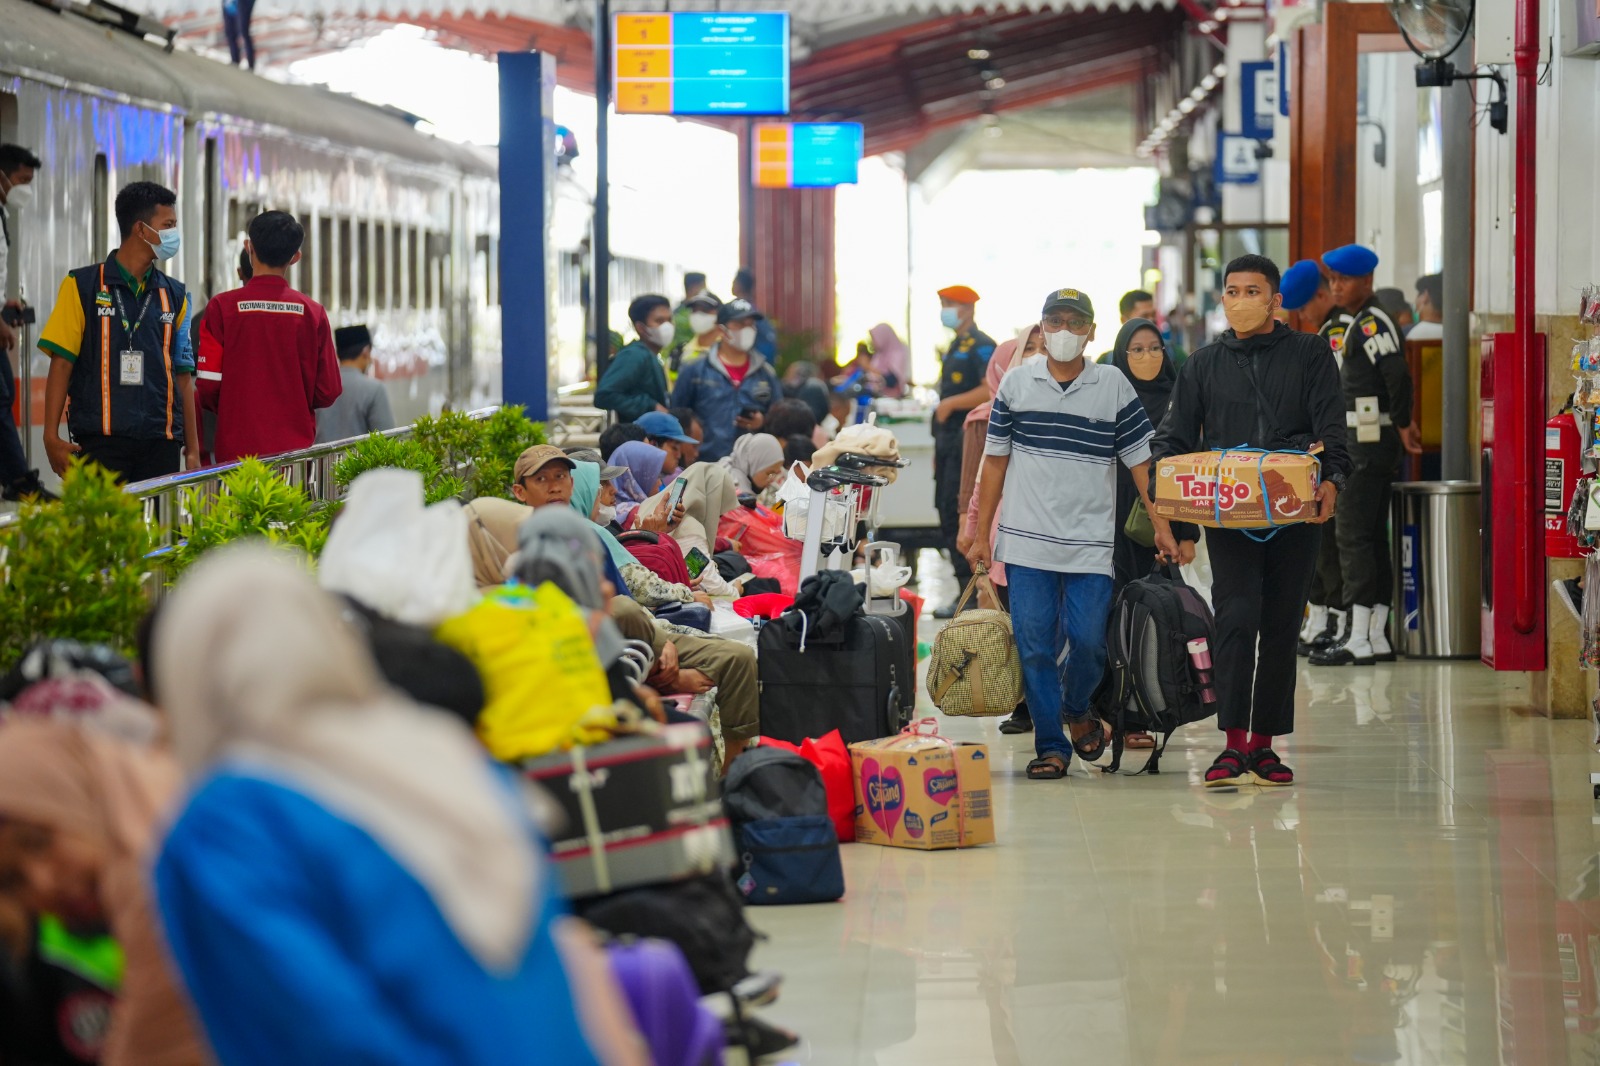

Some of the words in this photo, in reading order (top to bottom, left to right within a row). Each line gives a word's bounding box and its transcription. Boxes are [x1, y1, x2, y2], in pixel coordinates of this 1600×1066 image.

[97, 307, 115, 316] KAI
[239, 302, 265, 310] CUSTOMER
[266, 303, 285, 311] SERVICE
[286, 304, 303, 313] MOBILE
[1363, 332, 1397, 365] PM
[1175, 474, 1250, 510] Tango
[1180, 506, 1215, 516] Chocolate
[868, 782, 900, 807] Sayang
